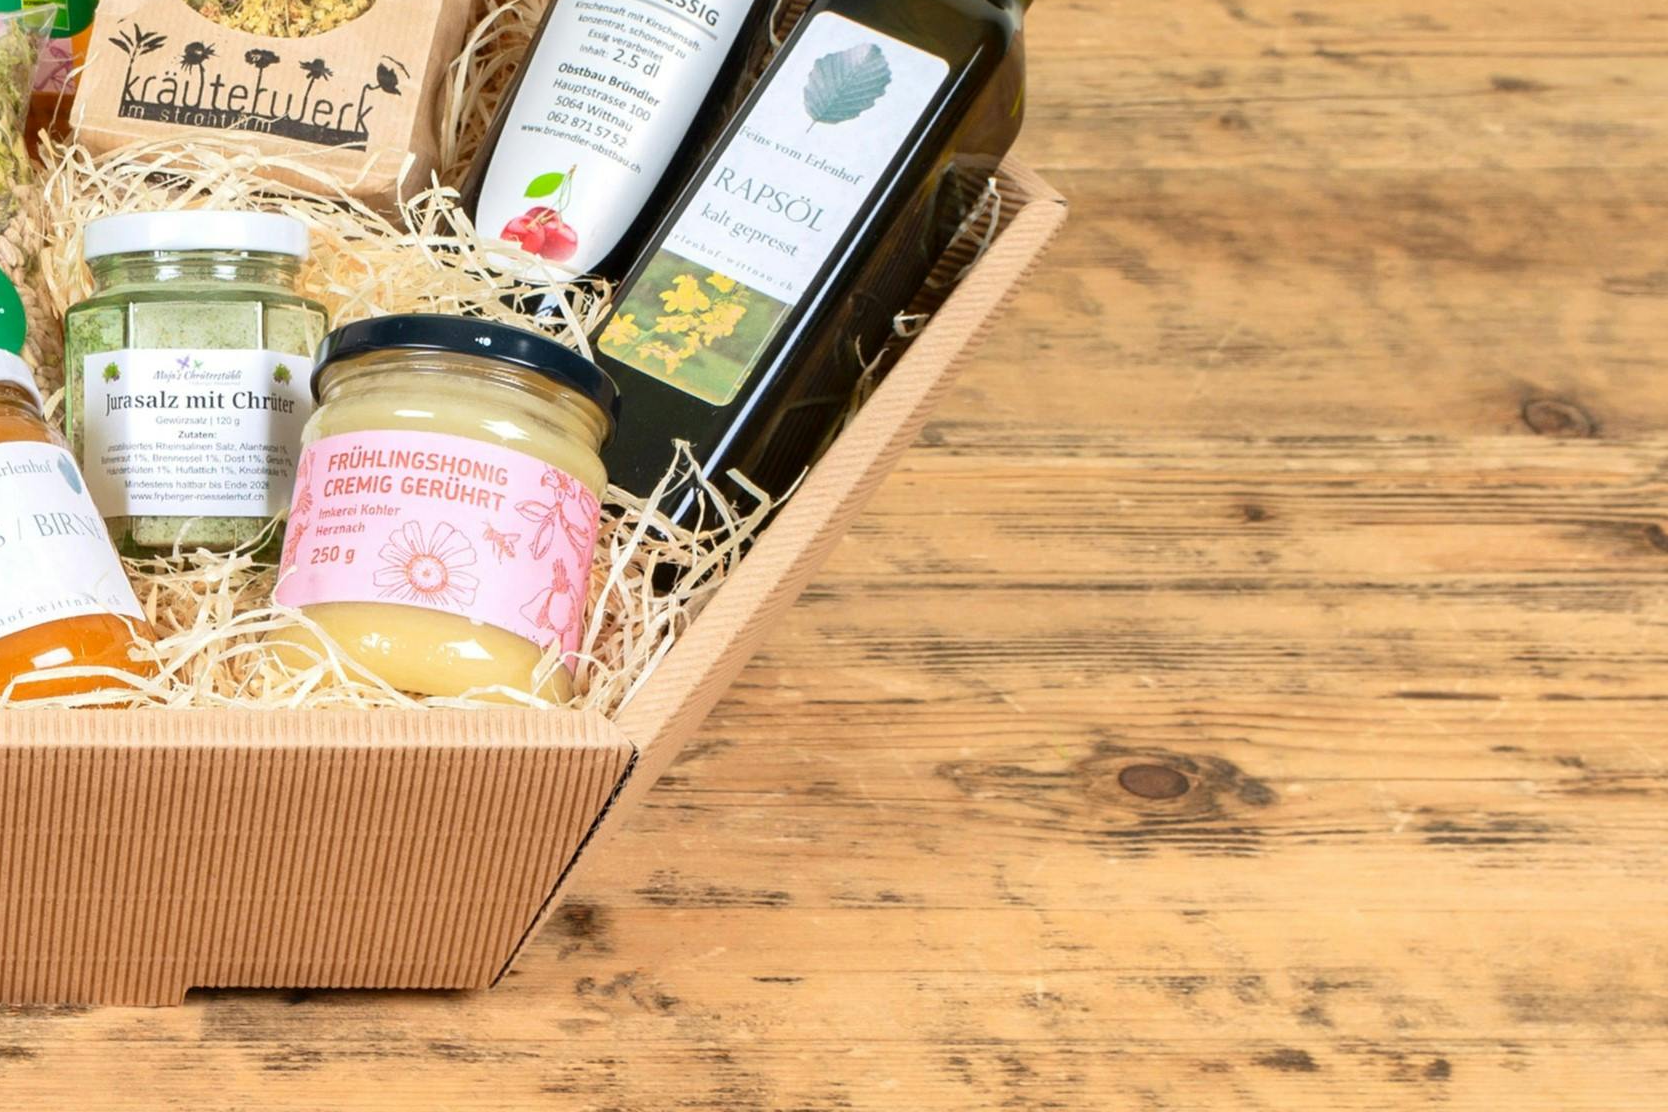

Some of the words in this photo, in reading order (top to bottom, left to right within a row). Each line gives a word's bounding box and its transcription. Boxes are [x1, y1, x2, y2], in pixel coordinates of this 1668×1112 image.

[575, 0, 626, 17] Kirschensaft
[627, 10, 644, 23] mit
[646, 15, 702, 52] Kirschensaft-
[577, 13, 626, 32] konzentrat,
[629, 27, 675, 51] schonend
[676, 50, 687, 59] zu
[579, 44, 608, 58] Inhalt:
[612, 48, 639, 70] 2.5
[643, 61, 661, 79] dl
[588, 28, 610, 43] Essig
[611, 35, 664, 62] verarbeitet
[121, 60, 374, 136] kräuterwerk
[552, 78, 627, 110] Hauptstrasse
[629, 104, 651, 122] 100
[558, 62, 606, 83] Obstbau
[608, 75, 661, 107] Bründler
[120, 104, 145, 118] im
[554, 95, 584, 111] 5064
[586, 103, 633, 133] Wittnau
[546, 111, 569, 125] 062
[570, 116, 592, 133] 871
[594, 125, 611, 140] 57
[611, 133, 627, 149] 52
[520, 124, 642, 175] www.bruendler-obstbau.ch
[738, 126, 771, 147] Feins
[774, 141, 802, 160] vom
[804, 153, 864, 187] Erlenhof
[713, 166, 825, 232] RAPSÖL
[701, 203, 732, 227] kalt
[729, 221, 799, 258] gepresst
[105, 390, 179, 416] Jurasalz
[186, 390, 224, 410] mit
[232, 391, 295, 414] Chrüter
[155, 416, 207, 425] Gewürzsalz
[216, 416, 231, 425] 120
[234, 418, 240, 426] g
[178, 430, 217, 439] Zutaten:
[156, 442, 212, 450] Rheinsalinen
[216, 442, 237, 451] Salz,
[224, 454, 245, 463] Dost
[176, 466, 217, 474] Huflattich
[327, 445, 508, 486] FRÜHLINGSHONIG
[124, 480, 173, 488] Mindestens
[175, 480, 206, 489] haltbar
[209, 480, 222, 489] bis
[224, 481, 247, 489] Ende
[324, 475, 392, 498] CREMIG
[400, 476, 506, 512] GERÜHRT
[16, 516, 23, 540] /
[316, 522, 365, 537] Herznach
[318, 504, 357, 520] Imkerei
[360, 504, 401, 517] Kohler
[310, 545, 340, 565] 250
[345, 547, 355, 564] g
